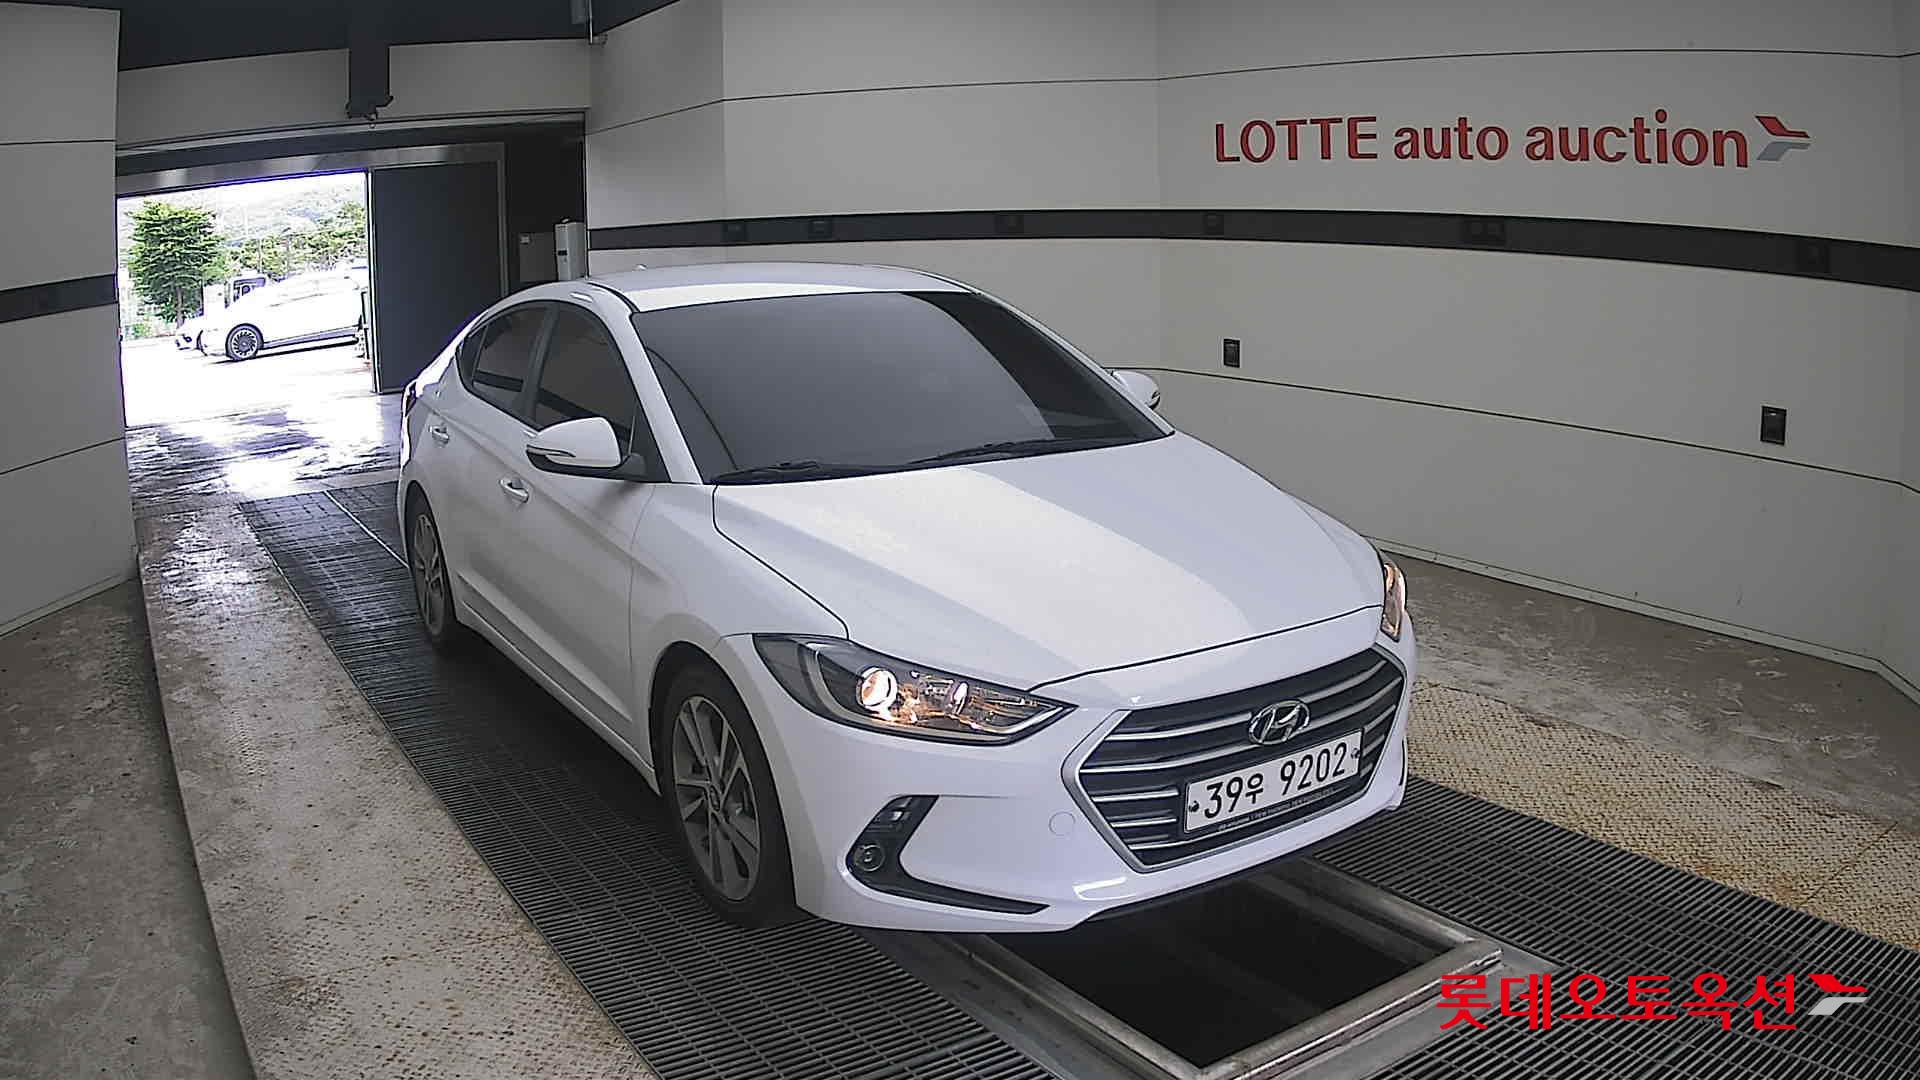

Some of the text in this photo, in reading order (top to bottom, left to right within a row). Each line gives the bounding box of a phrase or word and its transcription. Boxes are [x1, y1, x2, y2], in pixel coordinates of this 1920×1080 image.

[1215, 109, 1748, 168] LOTTE auto auction
[1204, 774, 1264, 819] 39우
[1280, 742, 1347, 796] 9202
